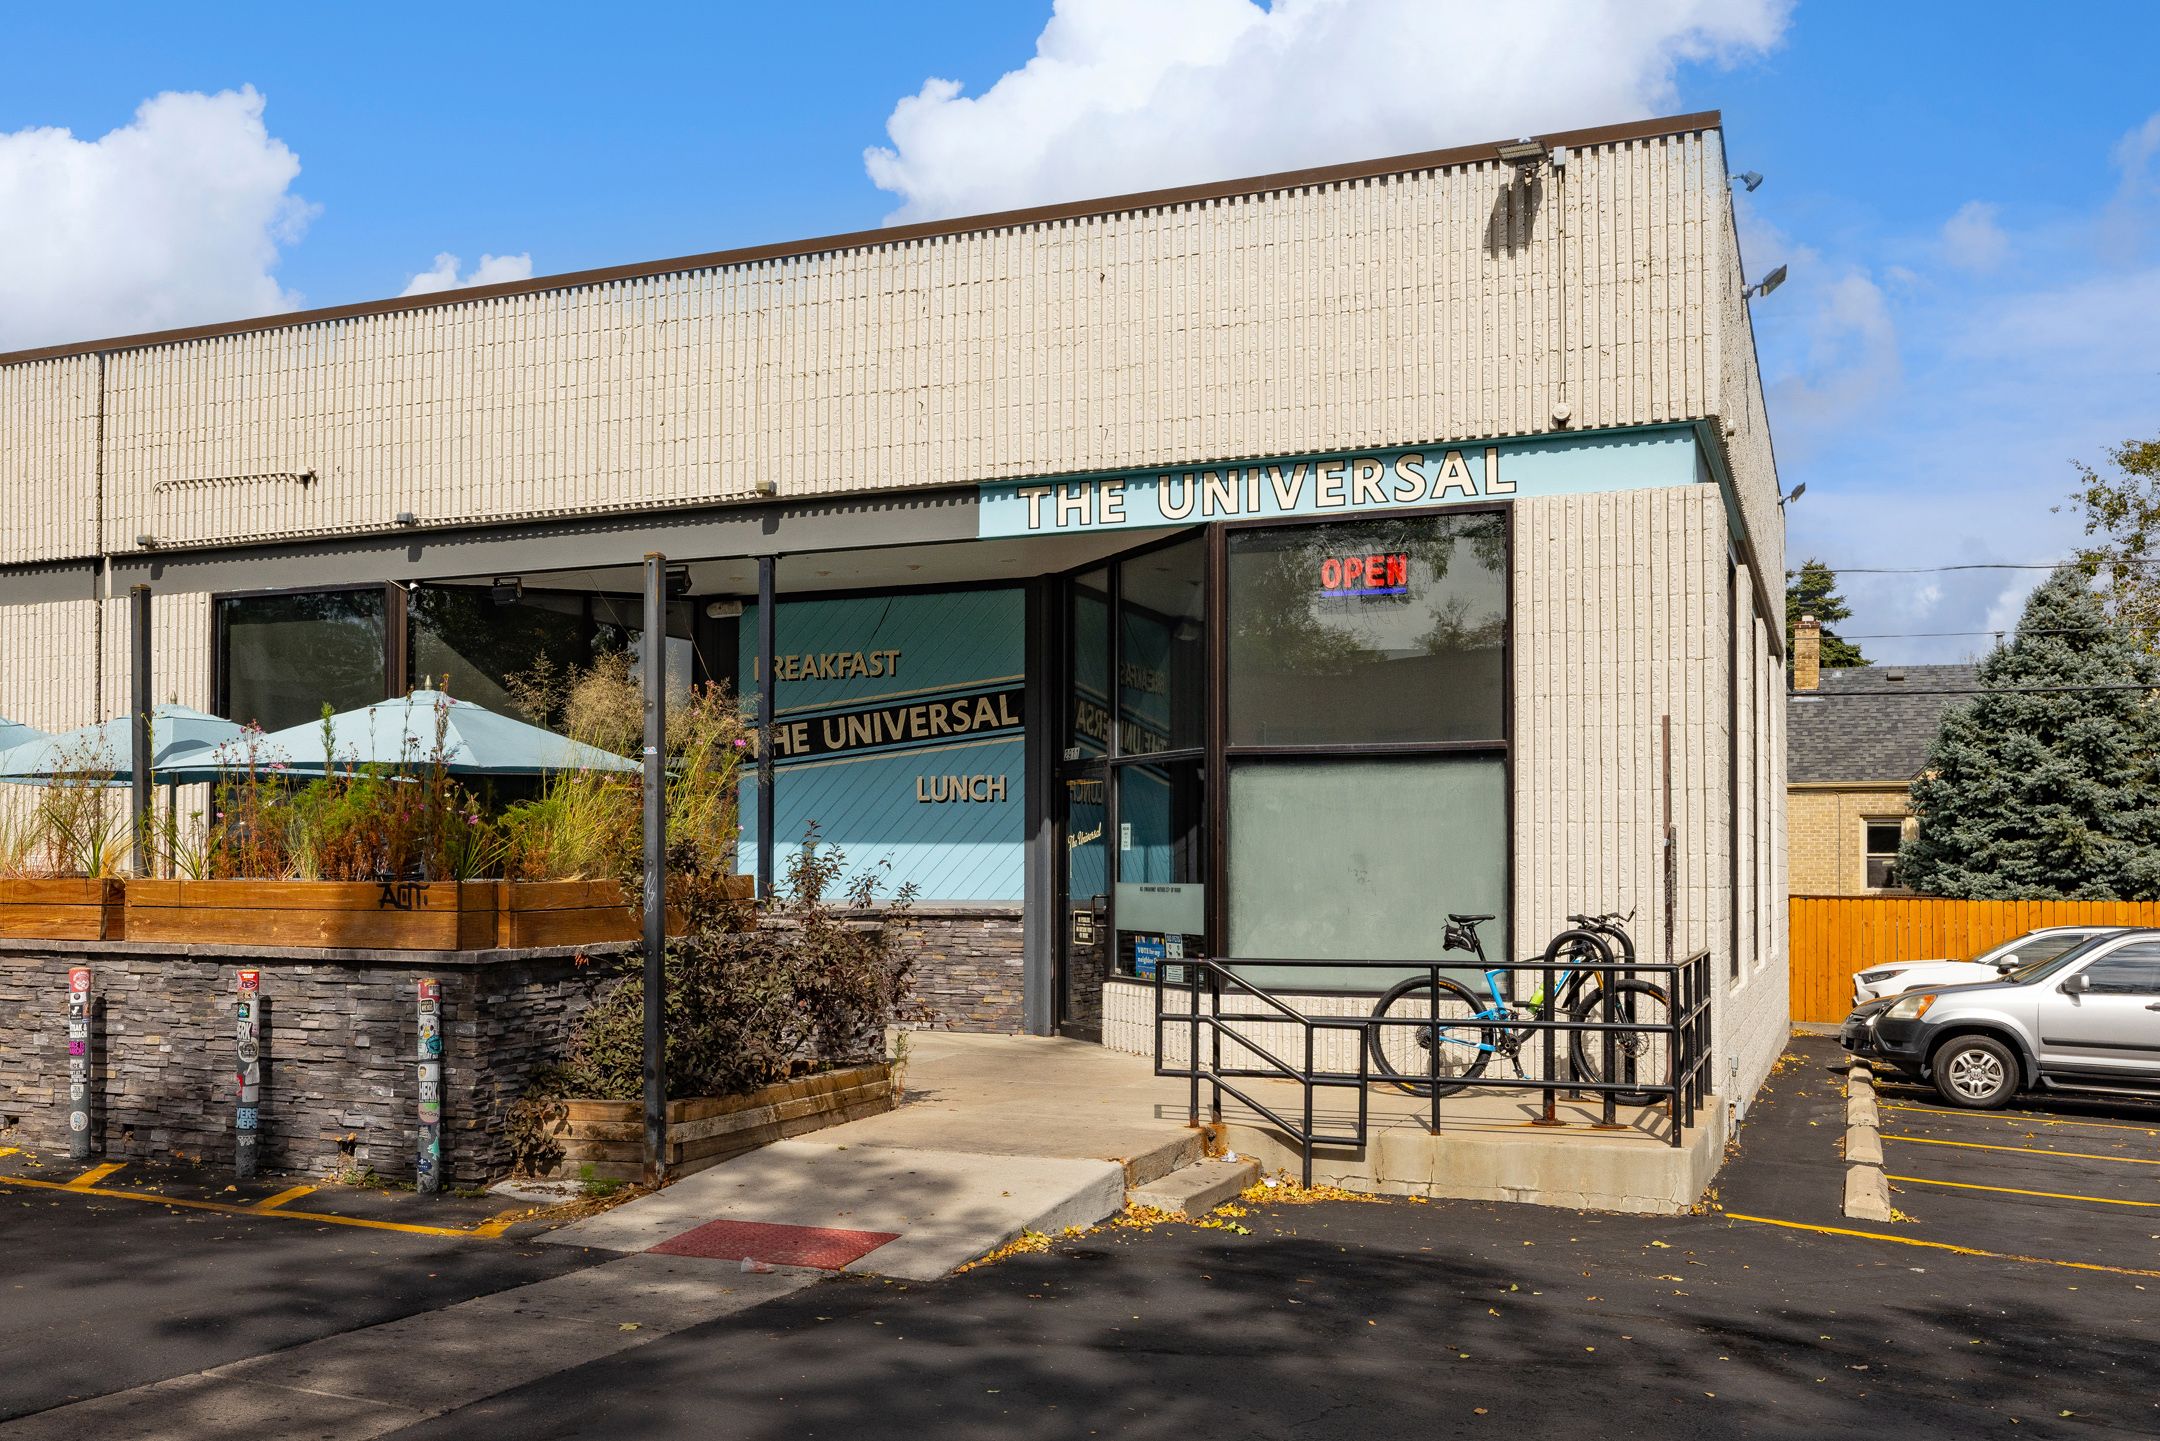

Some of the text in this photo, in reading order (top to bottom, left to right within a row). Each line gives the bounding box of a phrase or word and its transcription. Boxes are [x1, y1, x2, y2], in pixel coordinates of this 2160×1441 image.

[1018, 446, 1517, 530] THE UNIVERSAL
[1321, 552, 1407, 591] OPEN
[753, 649, 901, 681] REAKFAST
[823, 694, 1019, 750] UNIVERSAL
[916, 774, 1006, 803] LUNCH
